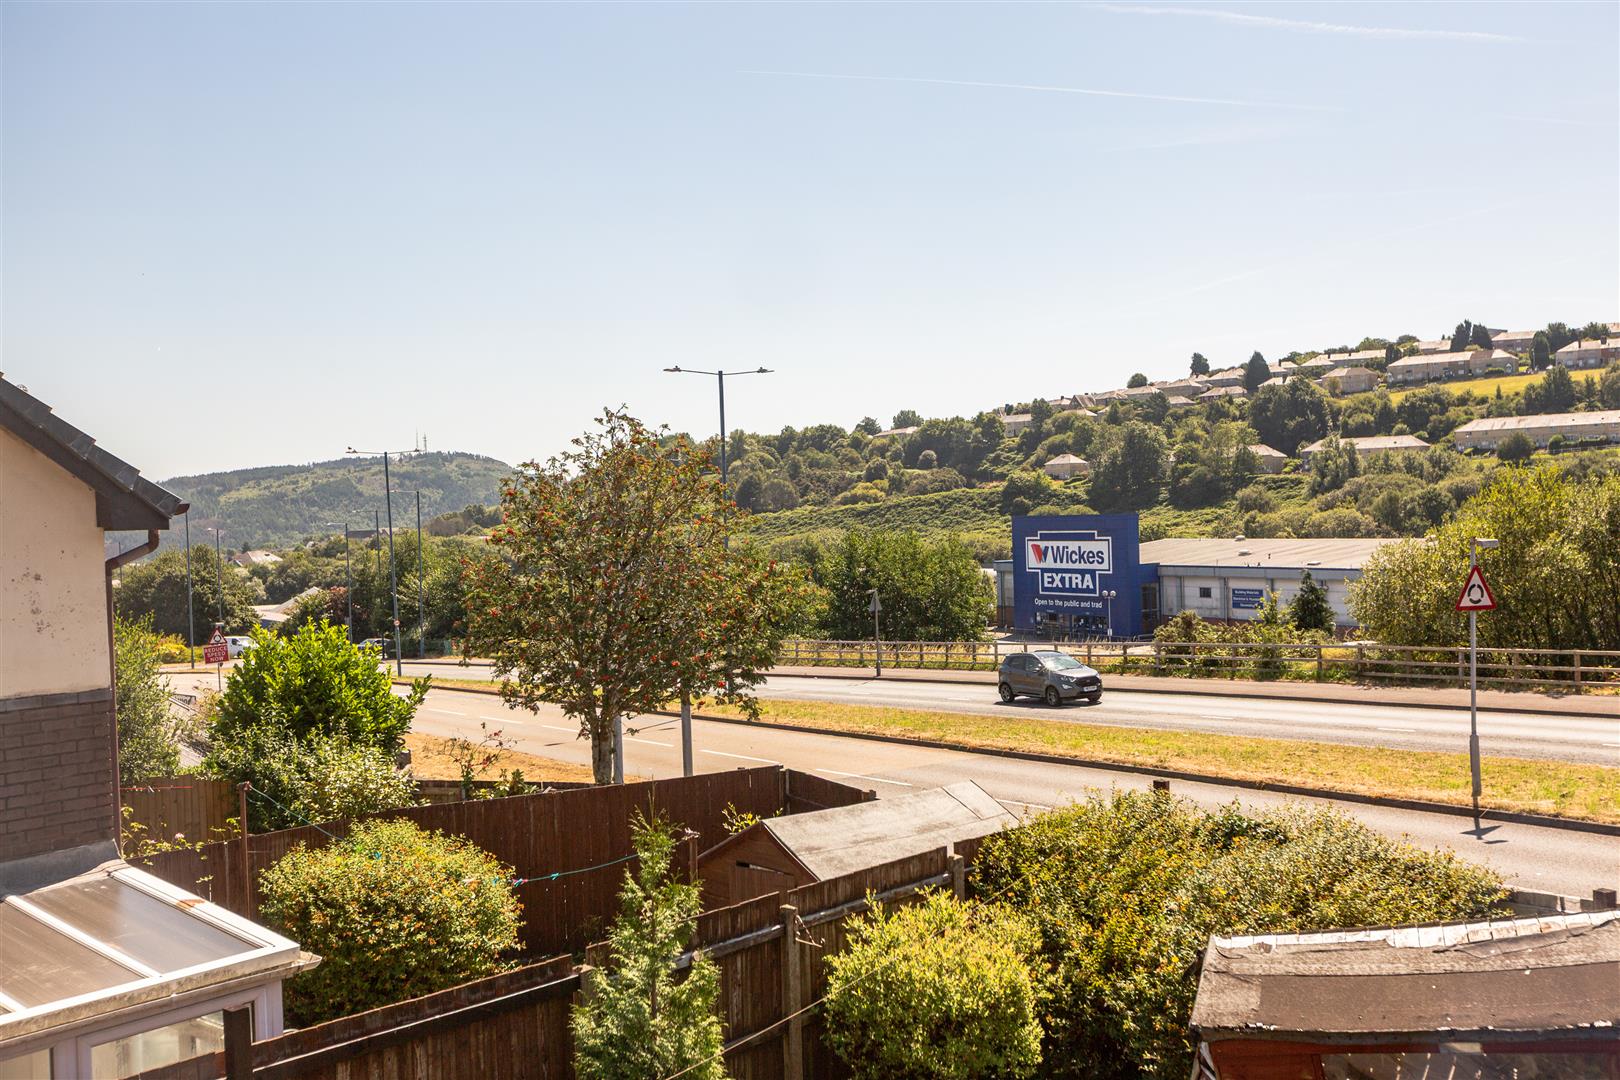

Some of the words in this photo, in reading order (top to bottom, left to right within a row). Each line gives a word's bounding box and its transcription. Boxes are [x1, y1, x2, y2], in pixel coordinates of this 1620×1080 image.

[1051, 546, 1105, 565] Wickes
[1043, 572, 1094, 589] EXTRA
[1034, 598, 1048, 606] Open
